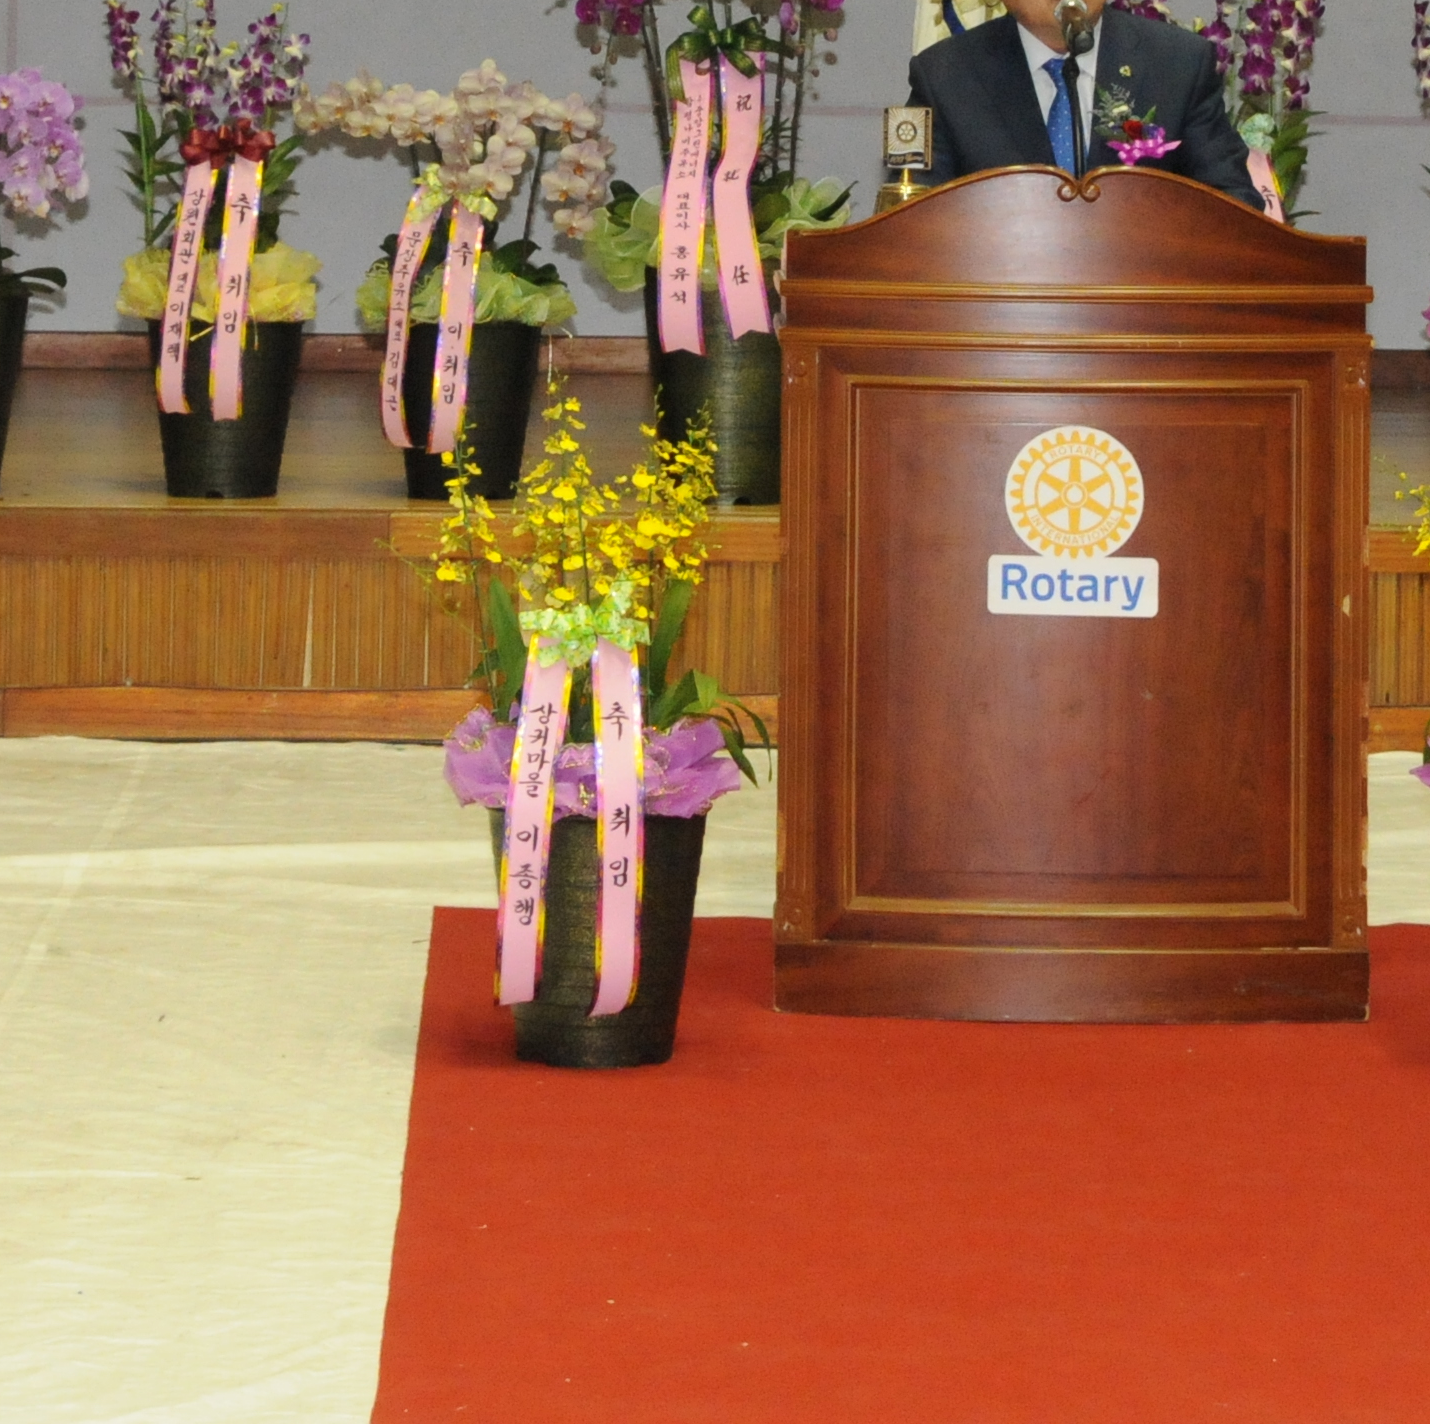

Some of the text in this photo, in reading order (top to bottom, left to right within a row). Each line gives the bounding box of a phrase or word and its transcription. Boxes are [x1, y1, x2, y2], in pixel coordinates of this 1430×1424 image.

[231, 192, 252, 225] 축
[454, 241, 473, 267] 축
[1049, 445, 1102, 461] ROTARY
[1031, 513, 1121, 546] INTERNATIONAL
[1001, 563, 1145, 611] Rotary
[601, 701, 630, 741] 축
